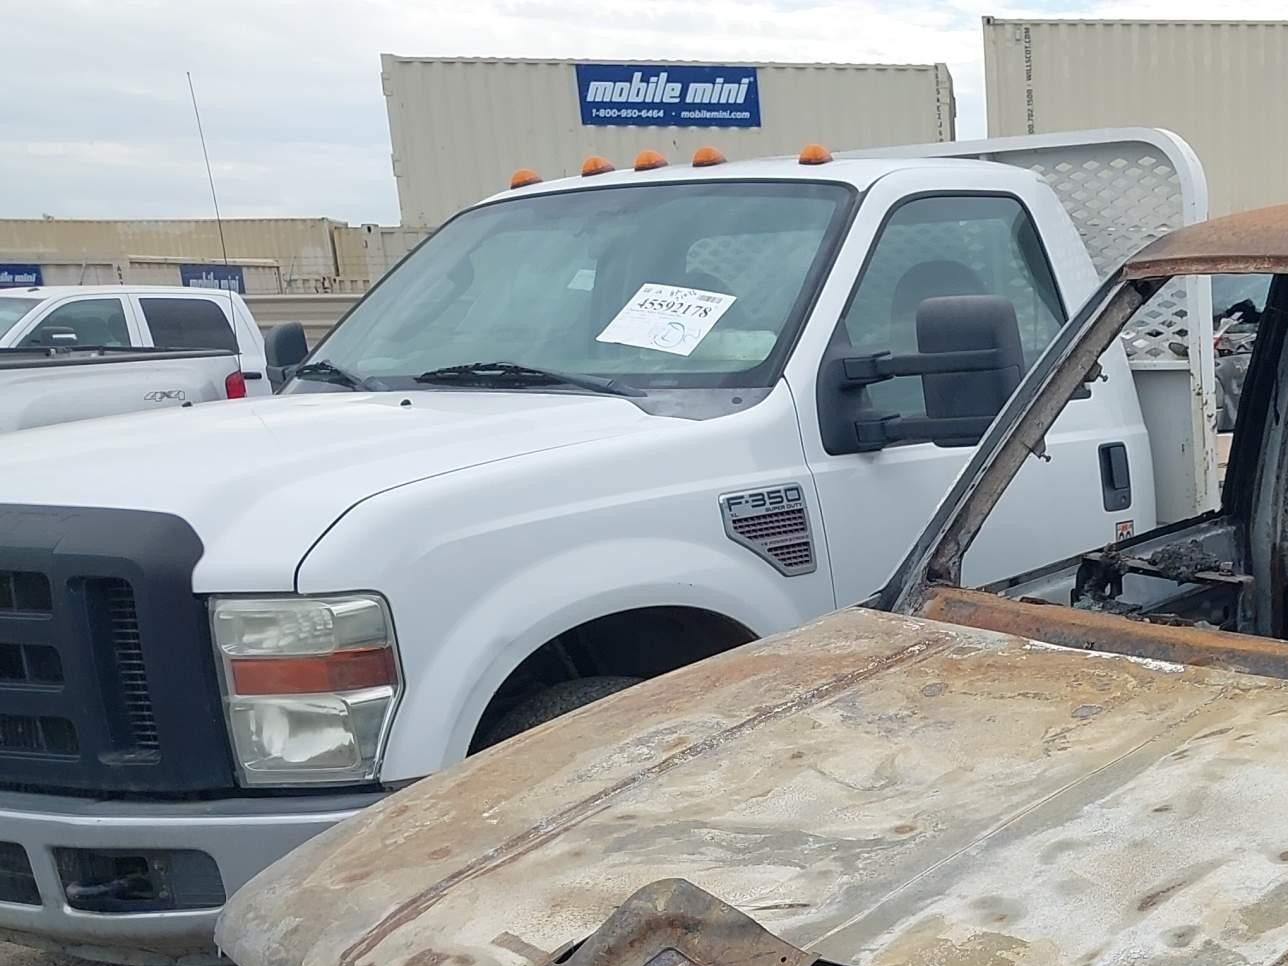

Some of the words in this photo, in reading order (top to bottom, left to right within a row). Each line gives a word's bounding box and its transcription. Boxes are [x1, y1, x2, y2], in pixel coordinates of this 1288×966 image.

[586, 72, 682, 103] mobile
[685, 77, 750, 104] mini
[592, 108, 664, 118] 1-800-950-6464
[681, 110, 750, 119] mobilemini.com
[638, 298, 712, 318] 45592178
